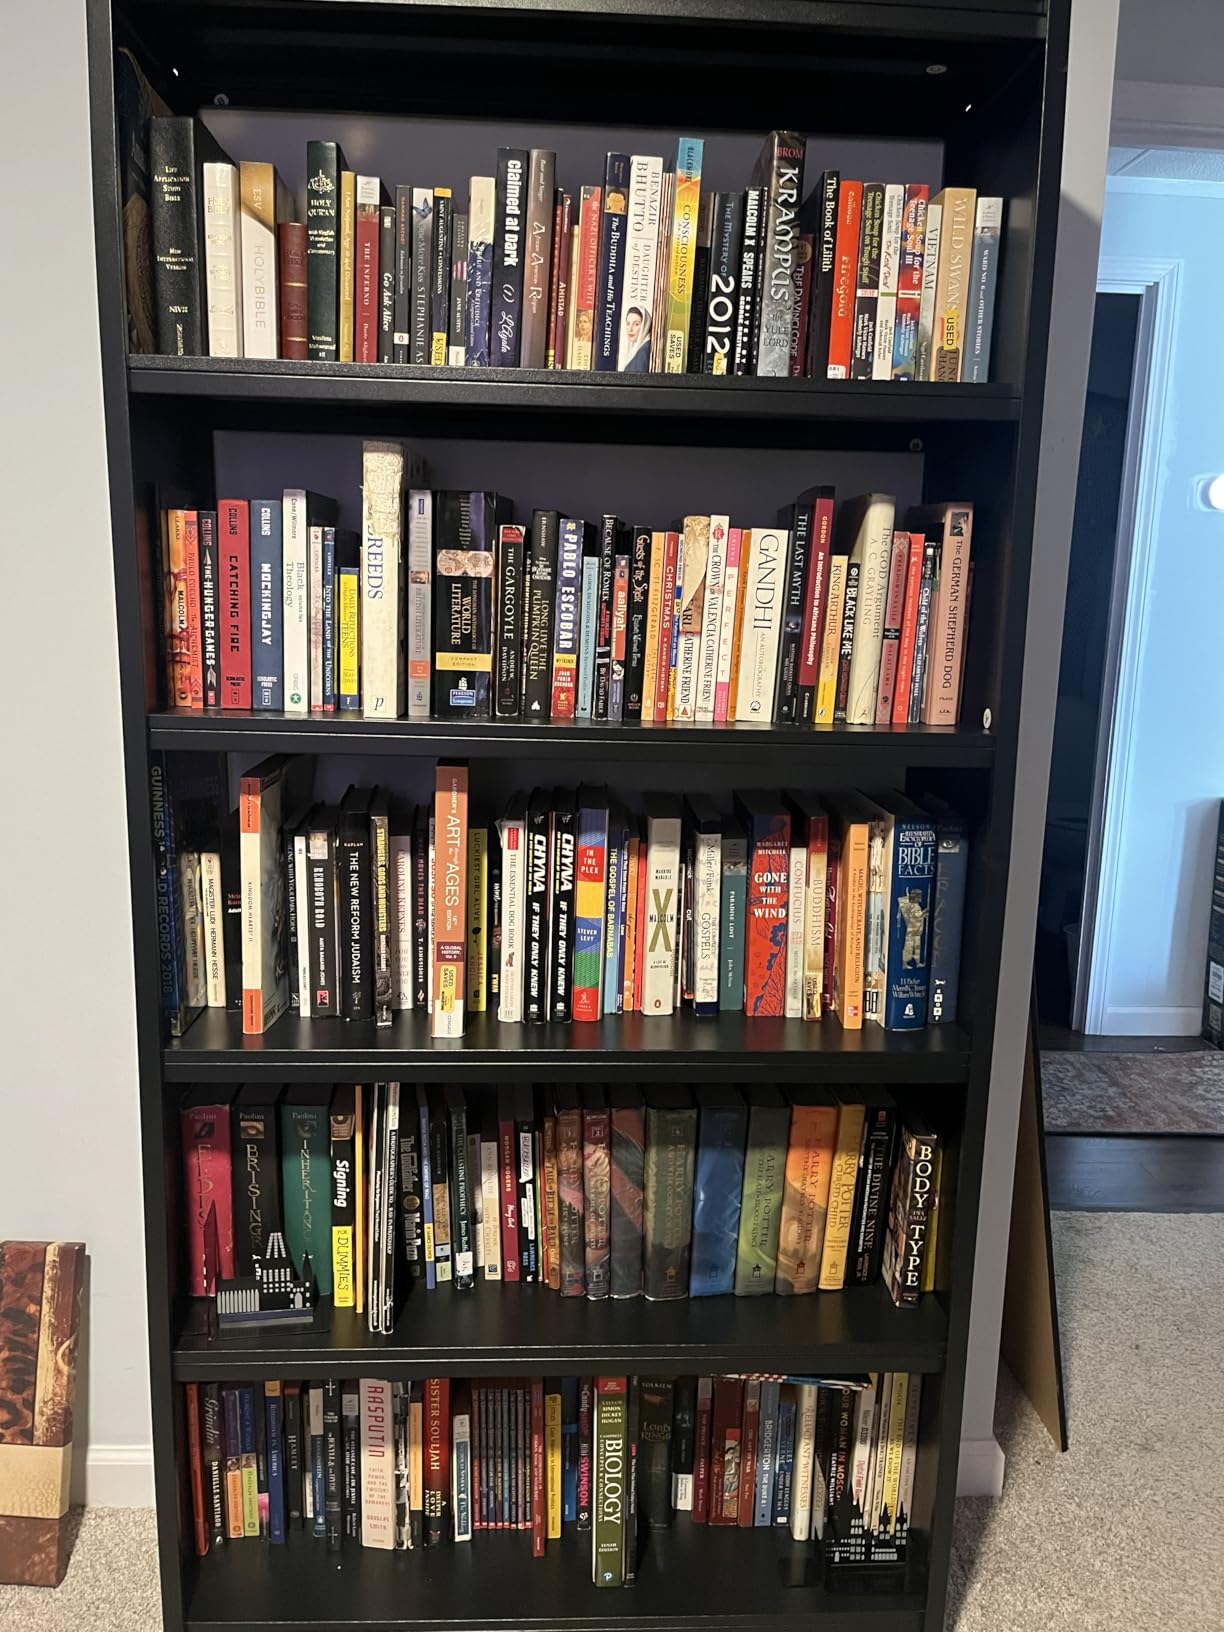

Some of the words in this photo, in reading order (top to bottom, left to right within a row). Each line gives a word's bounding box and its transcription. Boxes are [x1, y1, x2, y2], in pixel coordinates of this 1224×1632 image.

[685, 147, 695, 183] BLACKMORE
[253, 189, 261, 210] ESV
[507, 160, 522, 214] Claimed
[633, 162, 647, 232] BHUTTO
[649, 172, 660, 225] BENAZIR
[825, 178, 836, 199] The
[506, 218, 521, 231] at
[590, 214, 598, 234] NAZI
[745, 190, 759, 236] MALCOLM
[824, 201, 835, 228] Book
[952, 199, 967, 249] WILD
[503, 234, 520, 266] Dark
[677, 205, 691, 294] CONSCIOUSNESS
[720, 222, 732, 263] MYSTERY
[771, 167, 799, 302] KRAMPUS
[824, 230, 834, 242] of
[608, 232, 619, 273] BUDDHA
[822, 244, 833, 272] Lilith
[924, 227, 938, 289] VIETNAM
[383, 273, 392, 287] Go
[630, 255, 640, 300] DESTINY
[640, 244, 651, 301] DAUGHTER
[720, 266, 728, 277] OF
[741, 253, 754, 288] SPEAKS
[946, 255, 963, 311] SWANS
[383, 289, 392, 306] Ask
[558, 282, 566, 316] AMISTAD
[586, 285, 595, 304] WIFE
[382, 308, 392, 331] Alice
[603, 303, 616, 356] TEACHINGS
[707, 274, 735, 354] 2012
[946, 317, 954, 345] USED
[202, 519, 212, 545] COLLINS
[229, 508, 238, 535] COLLINS
[261, 508, 270, 535] COLLINS
[603, 519, 613, 555] BECAUSE
[796, 514, 808, 537] THE
[820, 516, 828, 543] GORDON
[562, 534, 578, 578] PABLO
[603, 558, 611, 569] OF
[794, 541, 806, 568] LAST
[955, 540, 963, 555] The
[204, 566, 212, 579] THE
[229, 556, 238, 618] CATCHING
[285, 562, 294, 608] Theology
[296, 562, 305, 590] Black
[602, 571, 612, 601] ROMEK
[753, 535, 779, 630] GANDHI
[790, 571, 804, 605] MYTH
[830, 565, 842, 591] KING
[950, 558, 962, 602] GERMAN
[203, 581, 213, 627] HUNGER
[261, 563, 271, 645] MOCKINGJAY
[451, 584, 461, 645] LITERATURE
[462, 596, 471, 633] WORLD
[503, 567, 515, 639] GARGOYLE
[530, 589, 542, 640] PUMPKIN
[540, 600, 549, 626] LONG
[615, 591, 626, 631] aaliyah
[663, 566, 674, 629] CHRISTMAS
[827, 593, 840, 636] ARTHUR
[844, 588, 857, 618] BLACK
[559, 586, 576, 649] ESCOBAR
[843, 620, 854, 639] LIKE
[944, 606, 959, 662] SHEPHERD
[205, 630, 215, 666] GAMES
[230, 625, 239, 652] FIRE
[539, 629, 548, 649] LIVE
[682, 632, 695, 675] CATHERINE
[841, 641, 852, 655] ME
[528, 643, 540, 679] QUEEN
[539, 652, 547, 670] THE
[943, 665, 955, 689] DOG
[680, 677, 692, 703] FRIEND
[446, 815, 461, 847] ART
[350, 852, 359, 872] THE
[532, 834, 546, 894] CHYNA
[560, 832, 574, 892] CHYNA
[610, 848, 618, 864] THE
[350, 874, 359, 896] NEW
[445, 864, 460, 906] AGES
[508, 870, 516, 908] ESSENTIAL
[609, 865, 617, 899] GOSPEL
[755, 872, 787, 883] GONE
[759, 886, 782, 894] WITH
[792, 861, 802, 924] CONFUCIUS
[532, 902, 540, 913] IF
[560, 901, 567, 912] IF
[608, 901, 616, 911] OF
[754, 908, 787, 918] WIND
[762, 897, 777, 905] THE
[811, 879, 823, 946] BUDDHISM
[351, 899, 360, 939] REFORM
[508, 910, 516, 927] DOG
[532, 915, 540, 938] THEY
[559, 914, 568, 937] THEY
[558, 941, 567, 964] ONLY
[607, 914, 616, 958] BARNABAS
[700, 912, 711, 960] GOSPELS
[351, 942, 361, 983] JUDAISM
[531, 942, 539, 966] ONLY
[530, 968, 538, 998] KNEW
[557, 967, 566, 996] KNEW
[333, 1160, 349, 1208] Signing
[914, 1146, 932, 1208] BODY
[868, 1173, 881, 1216] DIVINE
[864, 1220, 876, 1249] NINE
[336, 1237, 350, 1290] DUMMIES
[906, 1225, 924, 1287] TYPE
[430, 1379, 440, 1416] SISTER
[367, 1386, 384, 1457] RASPUTIN
[429, 1420, 440, 1470] SOULJAH
[762, 1420, 773, 1471] BRIDGERTON
[211, 1461, 219, 1493] DANIELLE
[580, 1457, 588, 1506] SWINSON
[604, 1439, 622, 1524] BIOLOGY
[213, 1495, 221, 1527] SANTIAGO
